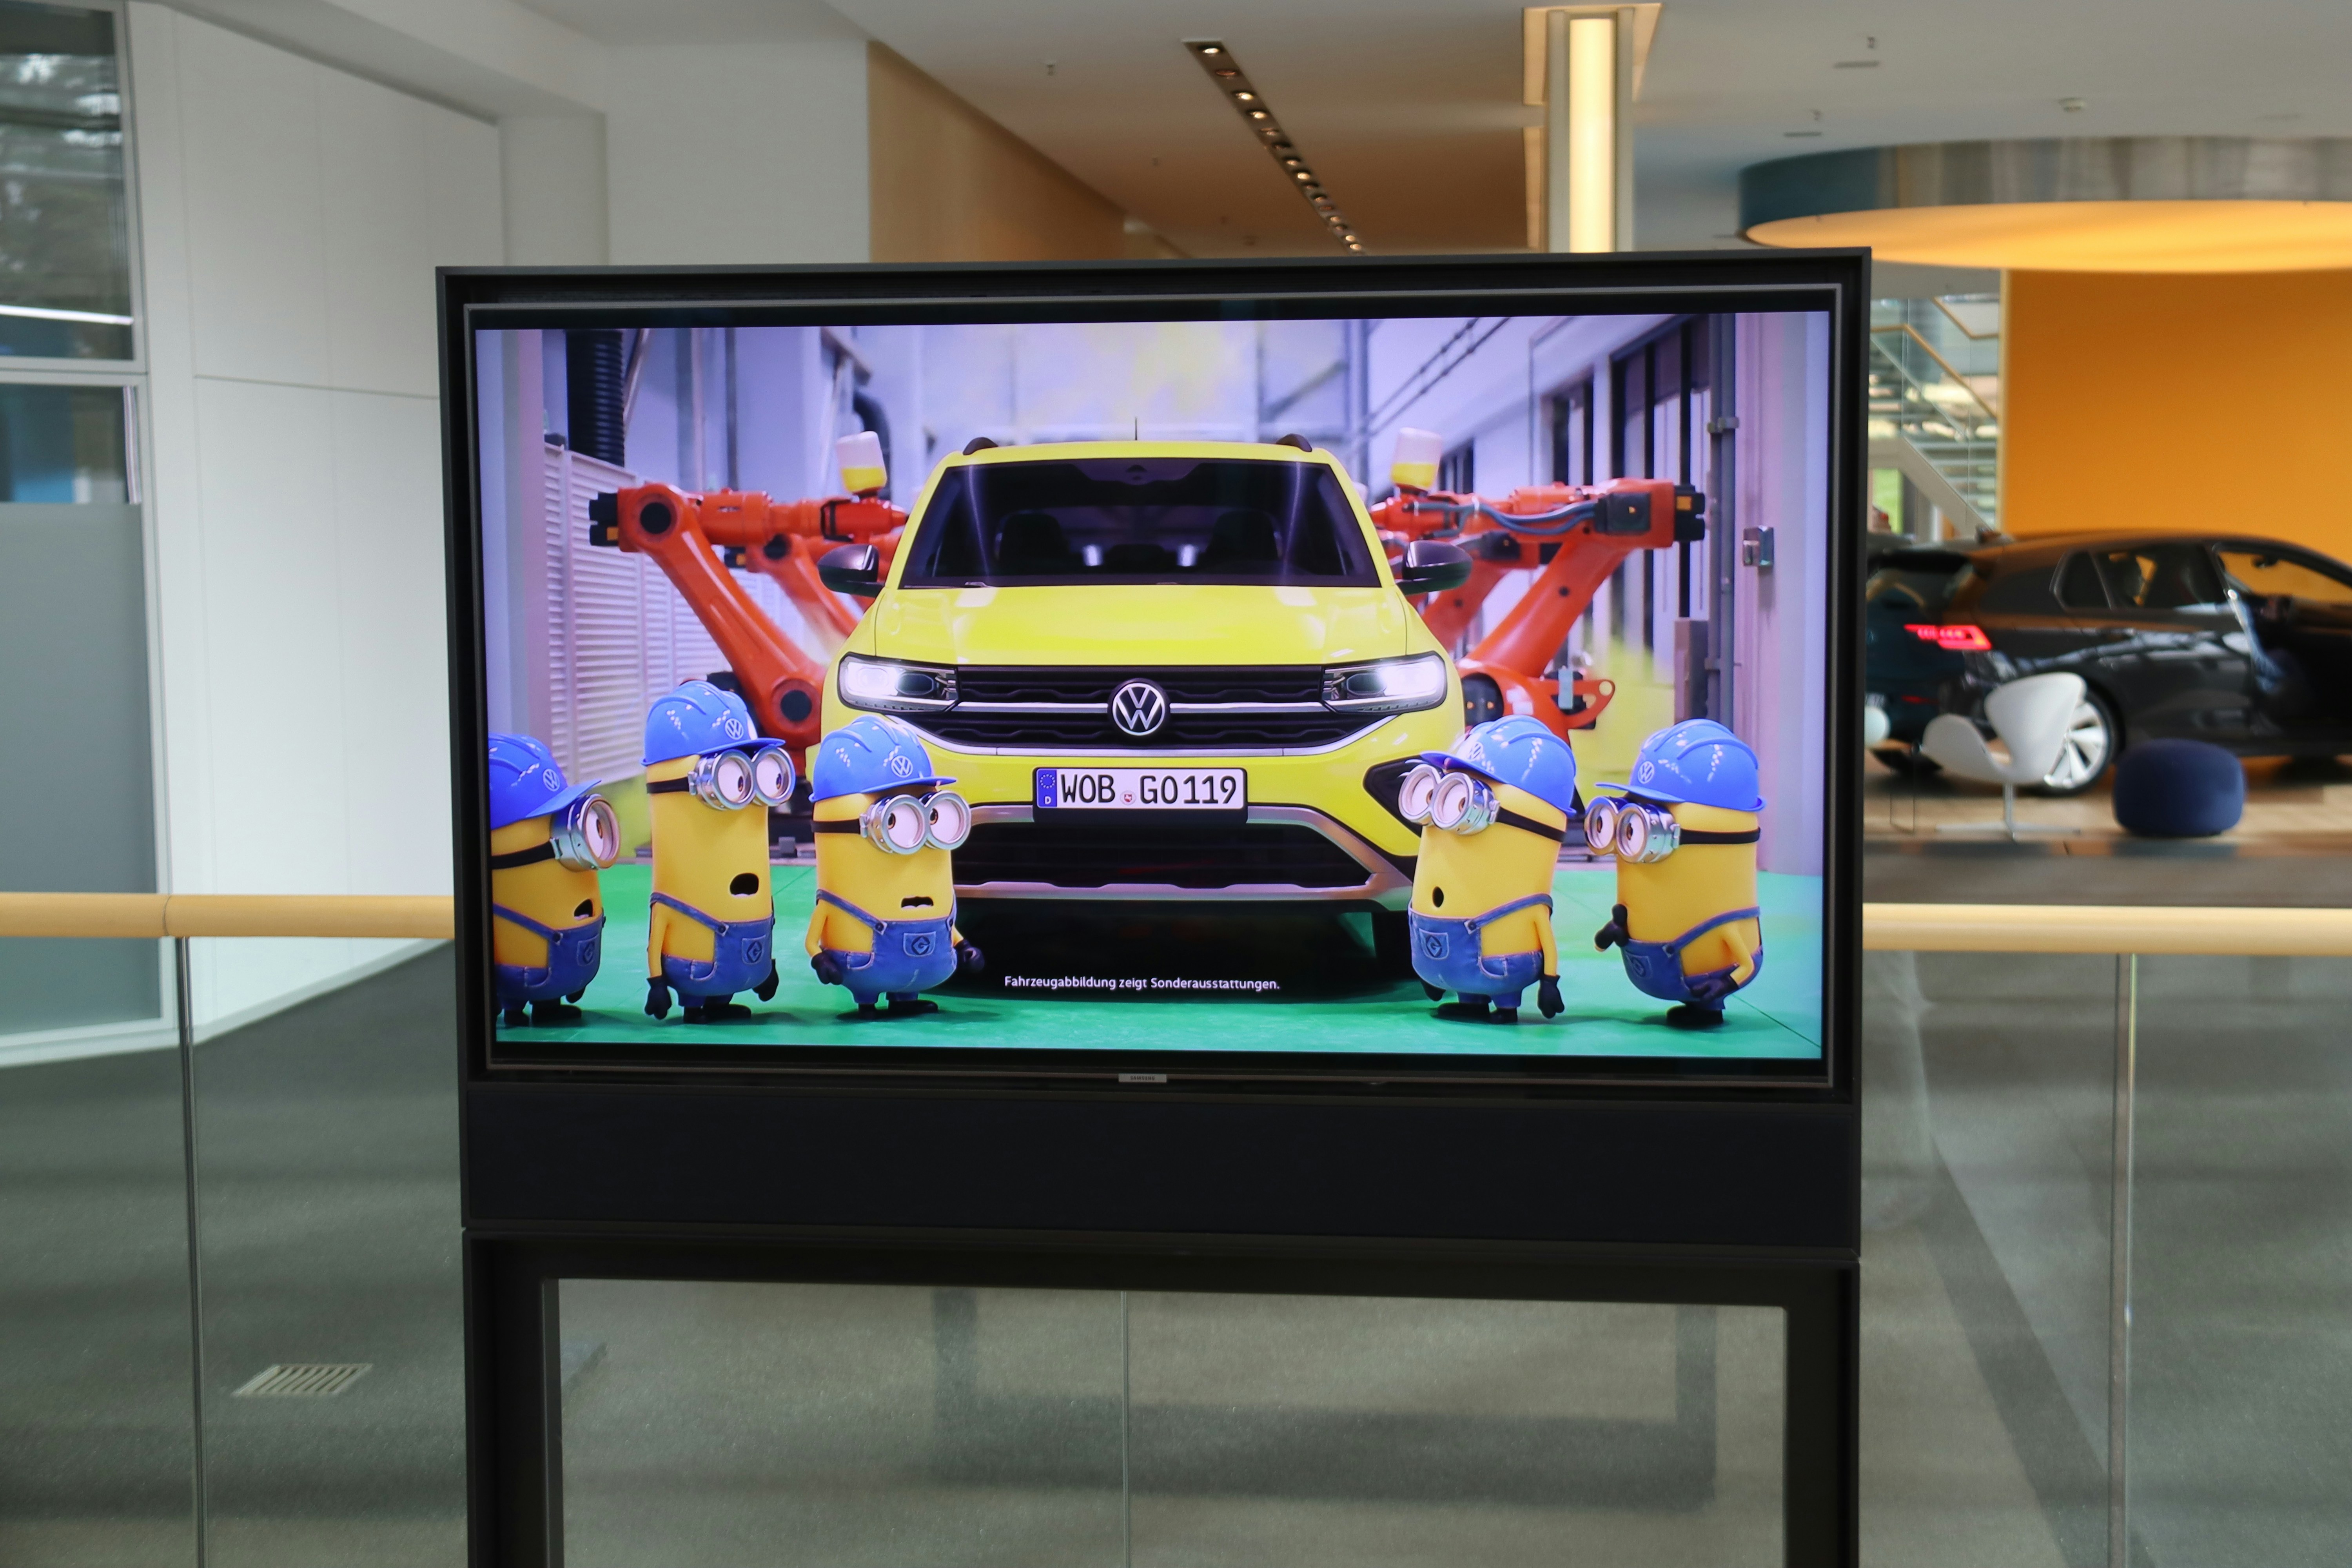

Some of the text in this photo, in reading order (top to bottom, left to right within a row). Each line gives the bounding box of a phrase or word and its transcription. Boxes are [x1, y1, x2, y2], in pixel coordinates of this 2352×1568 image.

[1112, 682, 1165, 735] VW
[724, 718, 744, 740] VW
[891, 755, 913, 778] VW
[1061, 774, 1115, 803] WOB
[1045, 796, 1051, 804] D
[1004, 976, 1280, 992] Fahrzeugabbildung zeigt Sonderausstattungen.
